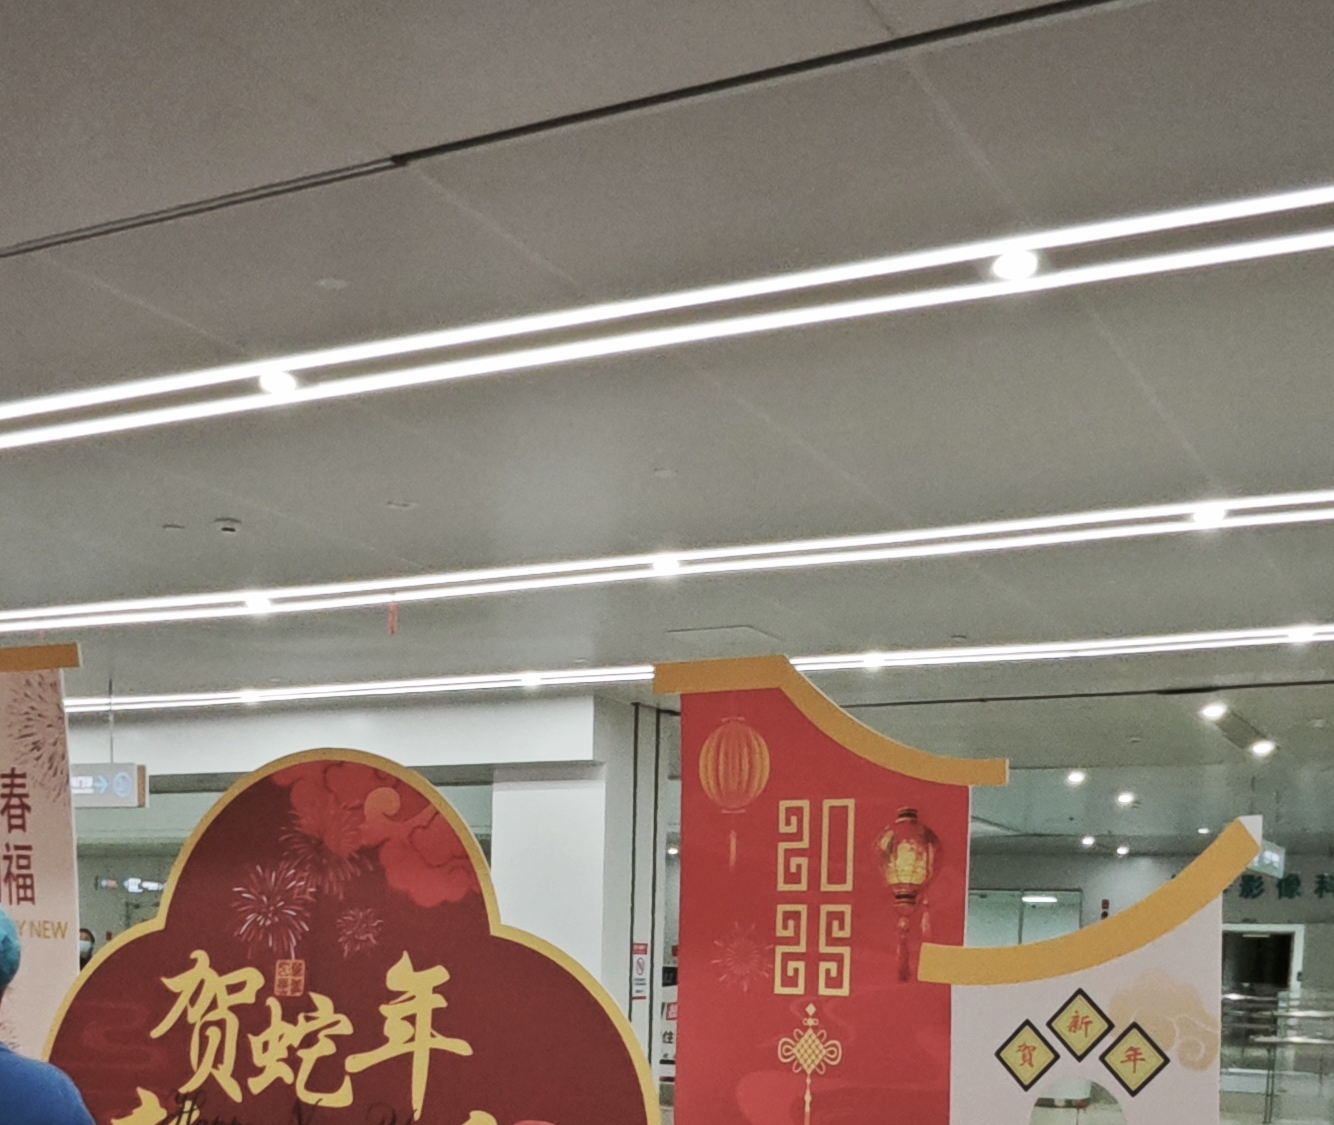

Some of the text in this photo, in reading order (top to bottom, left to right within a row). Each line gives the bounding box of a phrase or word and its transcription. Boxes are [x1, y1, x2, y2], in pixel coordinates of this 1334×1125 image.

[29, 919, 68, 939] NEW
[149, 949, 474, 1122] 贺蛇年
